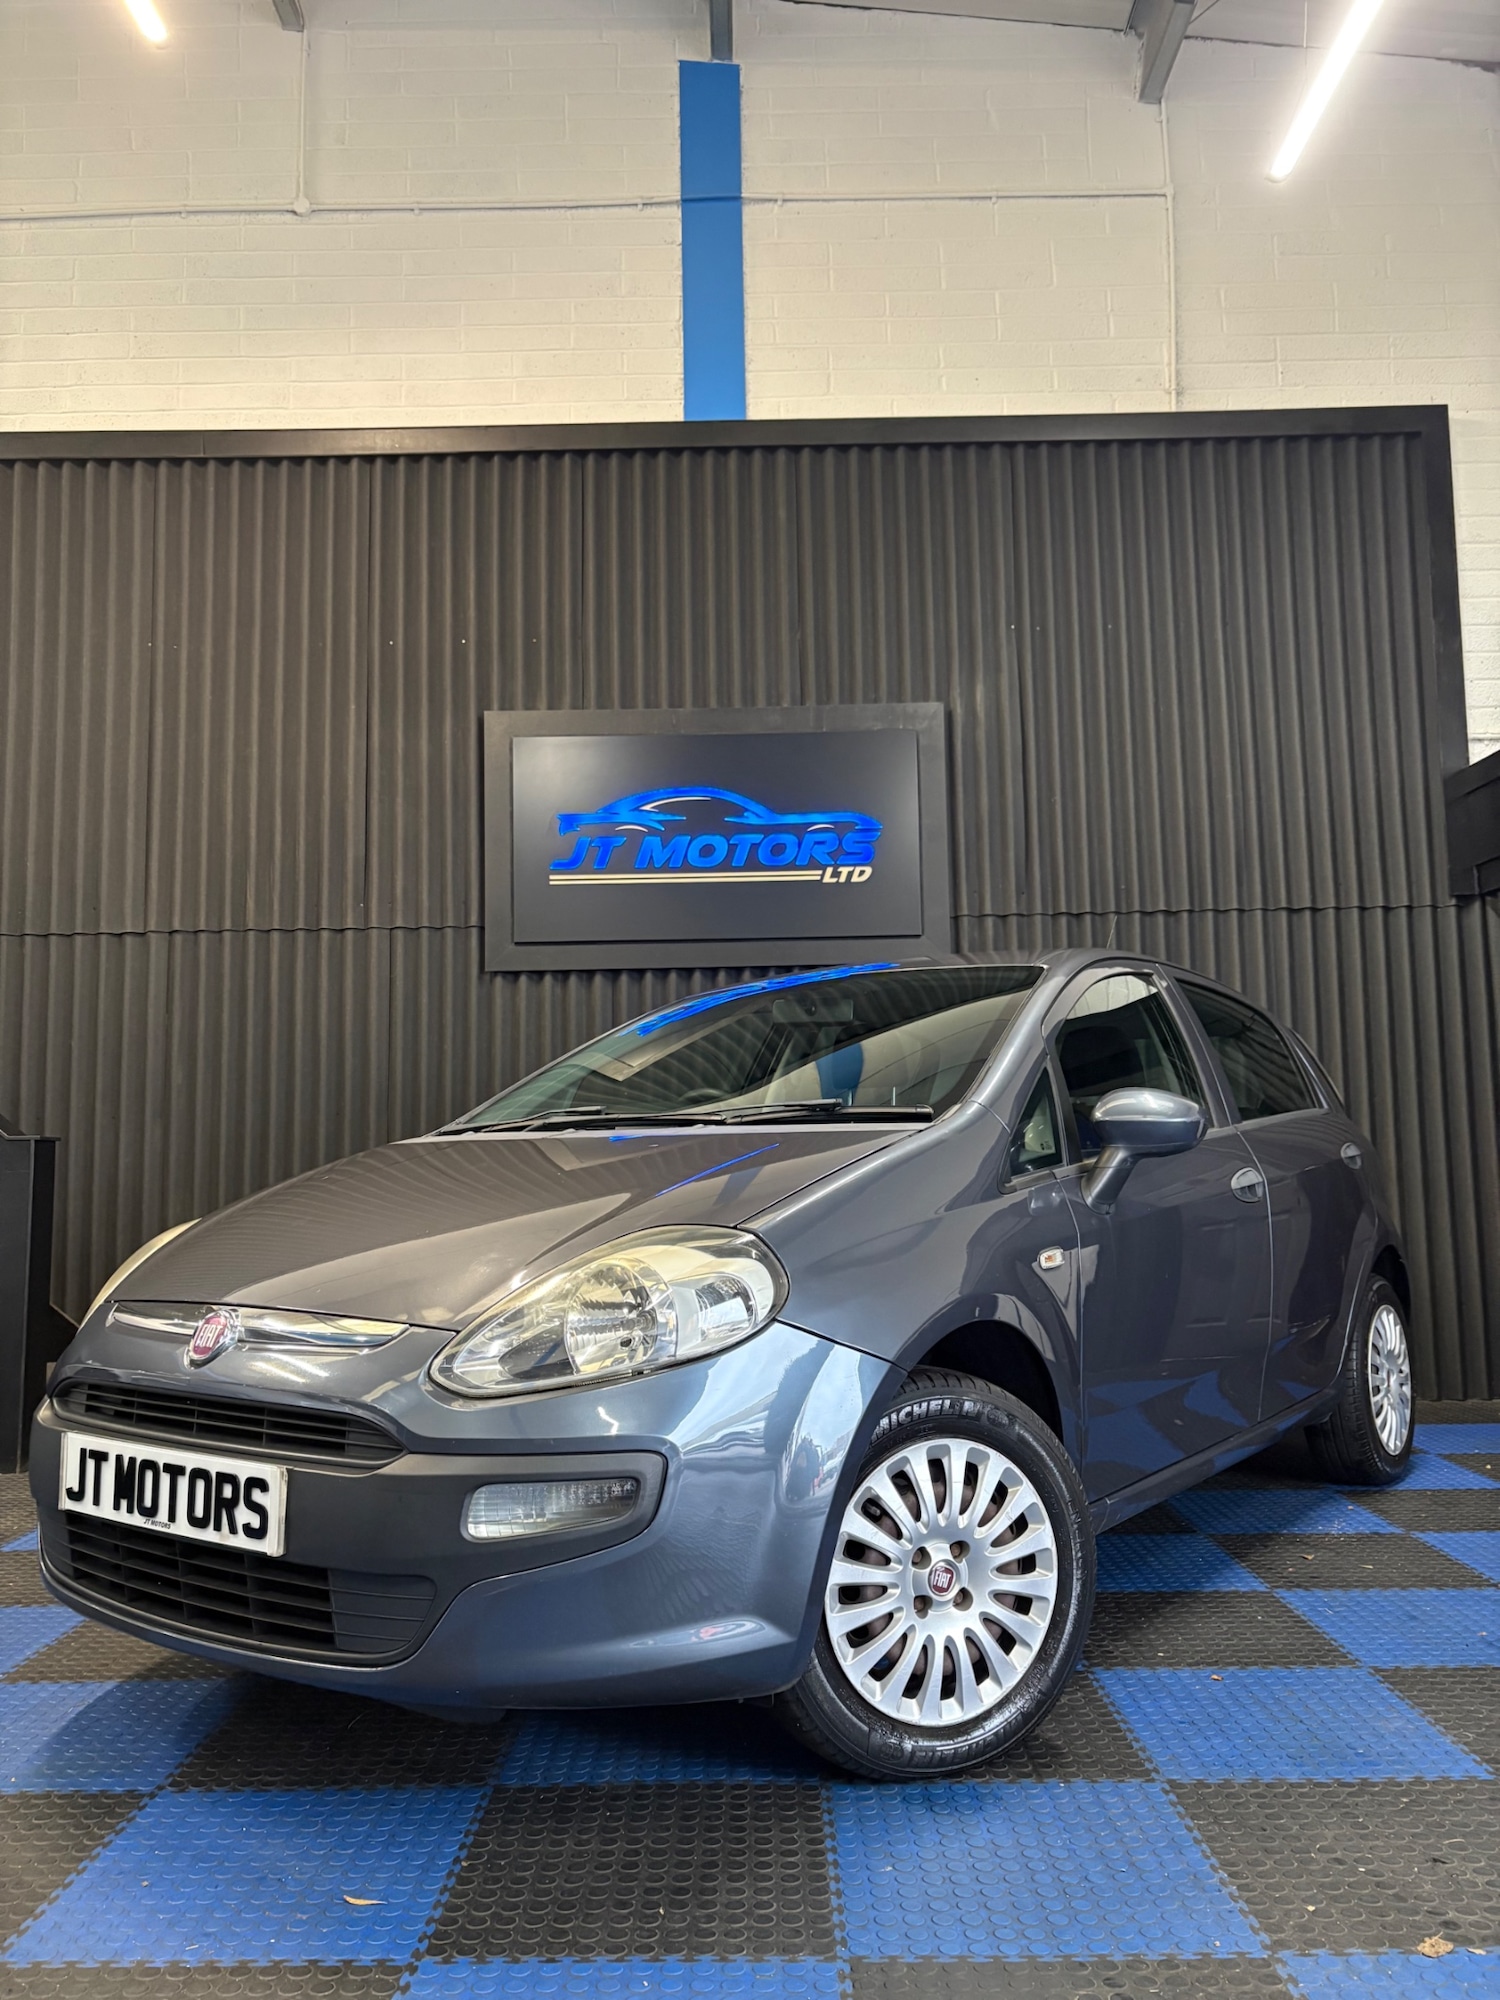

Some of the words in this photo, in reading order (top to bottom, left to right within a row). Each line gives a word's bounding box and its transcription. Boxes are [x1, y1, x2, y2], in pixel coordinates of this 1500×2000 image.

[549, 836, 626, 870] JT
[634, 831, 882, 869] MOTORS
[821, 866, 873, 884] LTD
[195, 1323, 223, 1348] FIAT
[871, 1399, 980, 1443] MICHELIN
[66, 1447, 109, 1507] JT
[113, 1453, 270, 1540] MOTORS
[150, 1519, 172, 1530] MOTORS
[933, 1570, 952, 1589] FIAT
